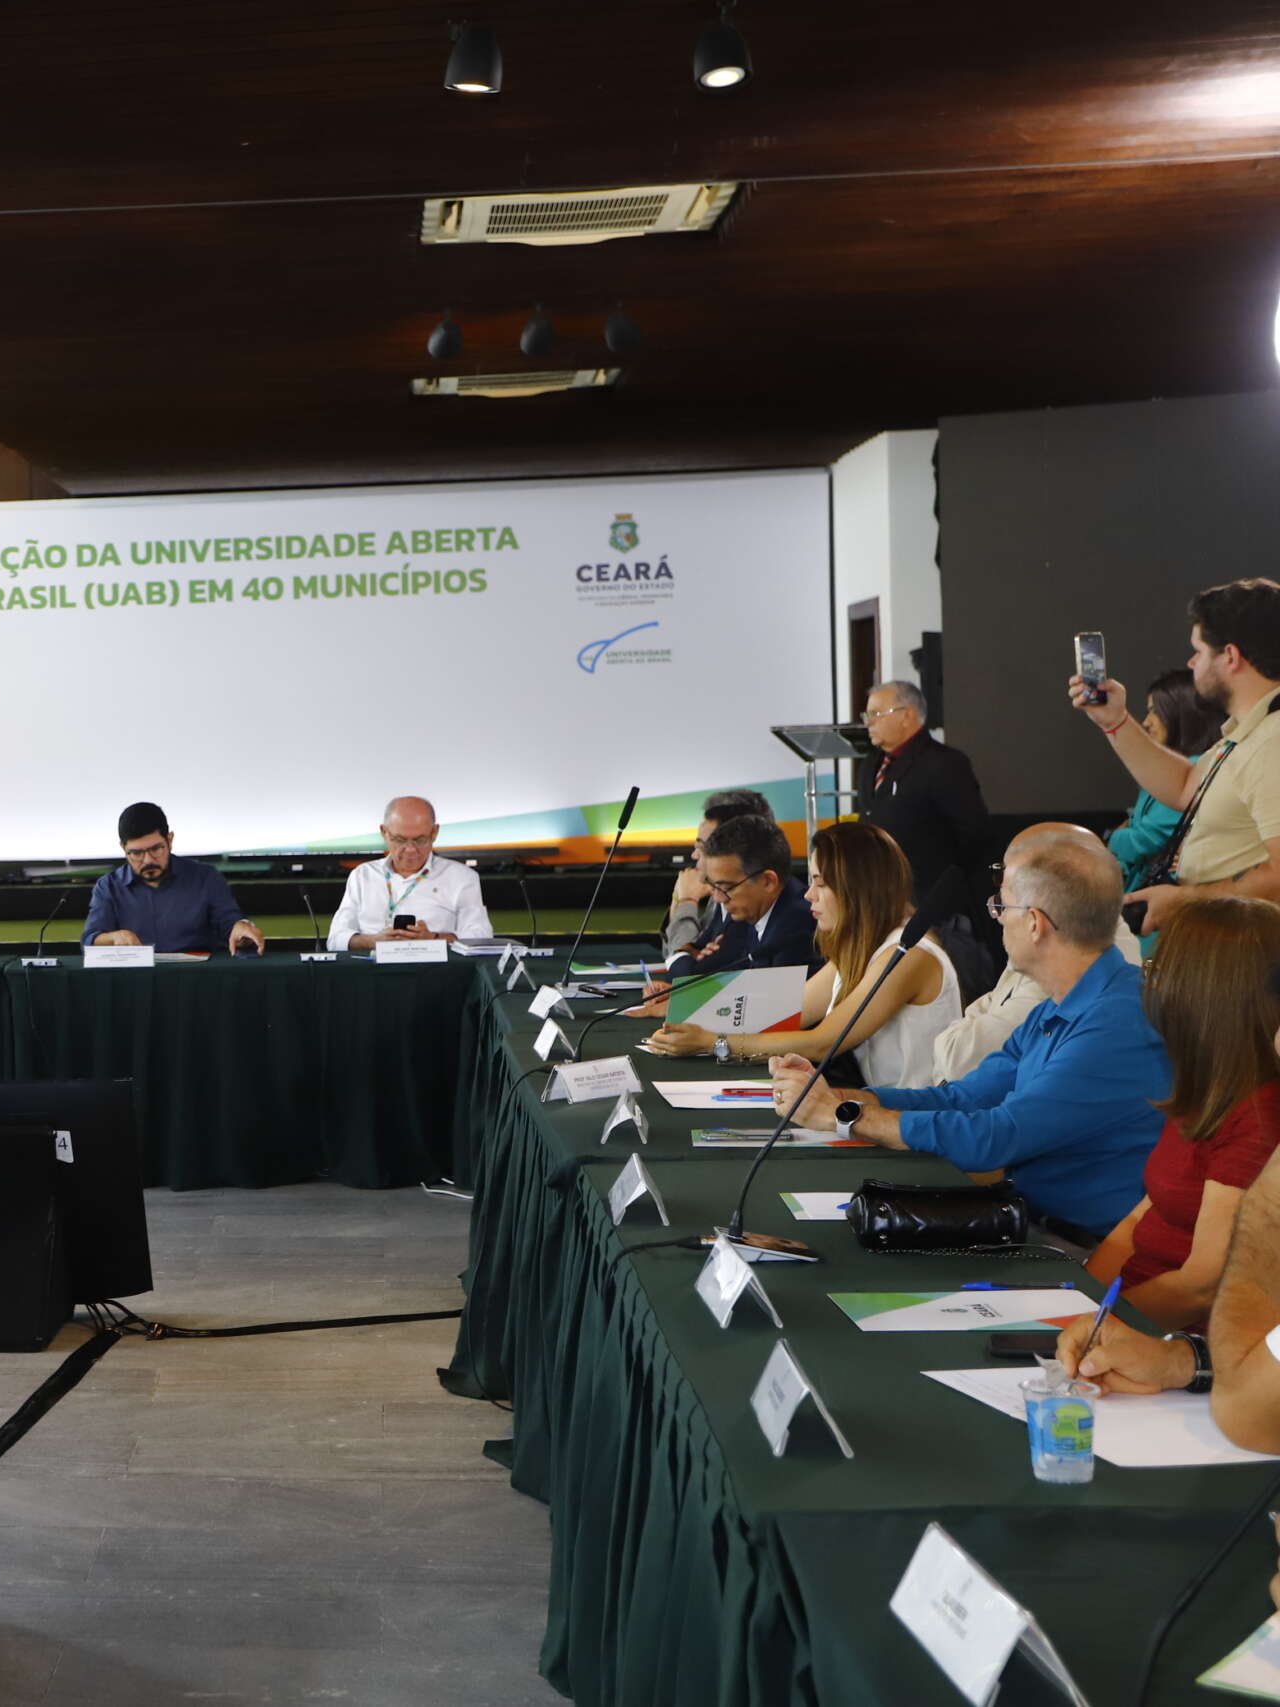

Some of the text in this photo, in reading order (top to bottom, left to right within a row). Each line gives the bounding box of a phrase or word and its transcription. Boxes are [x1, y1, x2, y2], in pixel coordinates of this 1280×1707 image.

[76, 543, 122, 568] DA
[130, 532, 376, 566] UNIVERSIDADE
[385, 526, 520, 555] ABERTA
[576, 554, 673, 583] CEARÁ
[83, 579, 180, 610] (UAB)
[188, 578, 233, 604] EM
[241, 576, 284, 601] 40
[292, 562, 487, 599] MUNICÍPIOS
[576, 585, 620, 593] GOVERNO
[639, 582, 674, 590] ESTADO
[733, 995, 745, 1027] CEARÁ
[58, 1137, 68, 1150] 4
